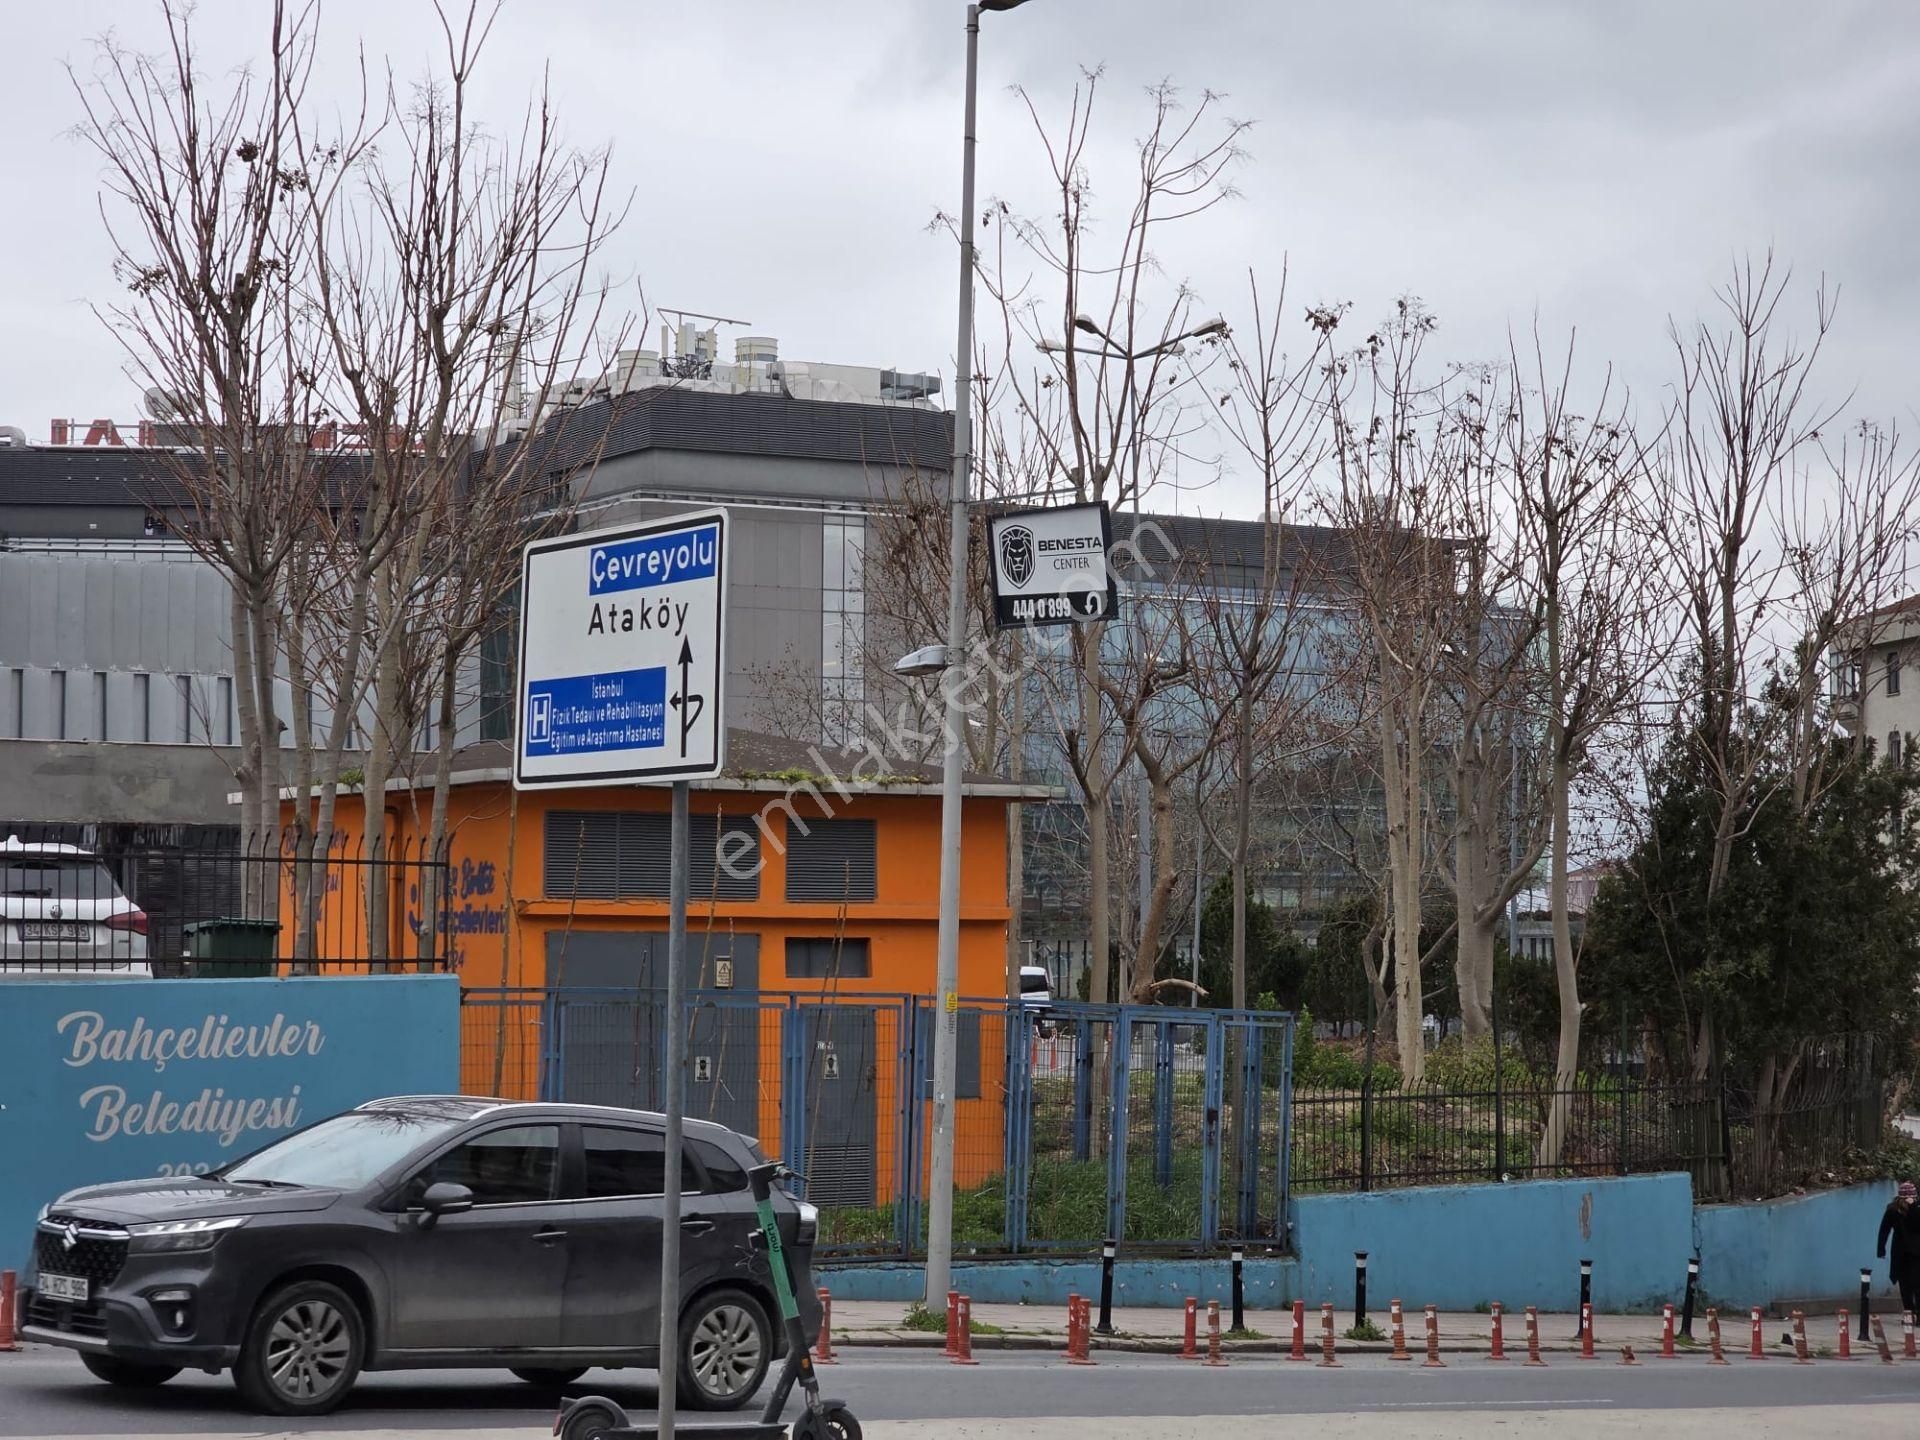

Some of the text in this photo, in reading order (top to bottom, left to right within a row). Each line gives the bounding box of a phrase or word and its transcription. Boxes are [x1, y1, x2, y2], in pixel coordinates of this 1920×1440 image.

[1038, 536, 1102, 551] BENESTA
[592, 534, 712, 588] Çevreyolu
[1054, 558, 1090, 570] CENTER
[588, 597, 689, 636] Ataköy
[1013, 598, 1071, 619] 444 0 899
[592, 678, 623, 698] İstanbul
[552, 702, 663, 726] Fizik Tedavi ve Rehabilitasyon
[551, 724, 663, 752] Eğitim ve Araştırma Hastanesi
[26, 924, 40, 936] 34
[57, 1010, 327, 1072] Bahçelievler
[79, 1084, 303, 1147] Belediyesi
